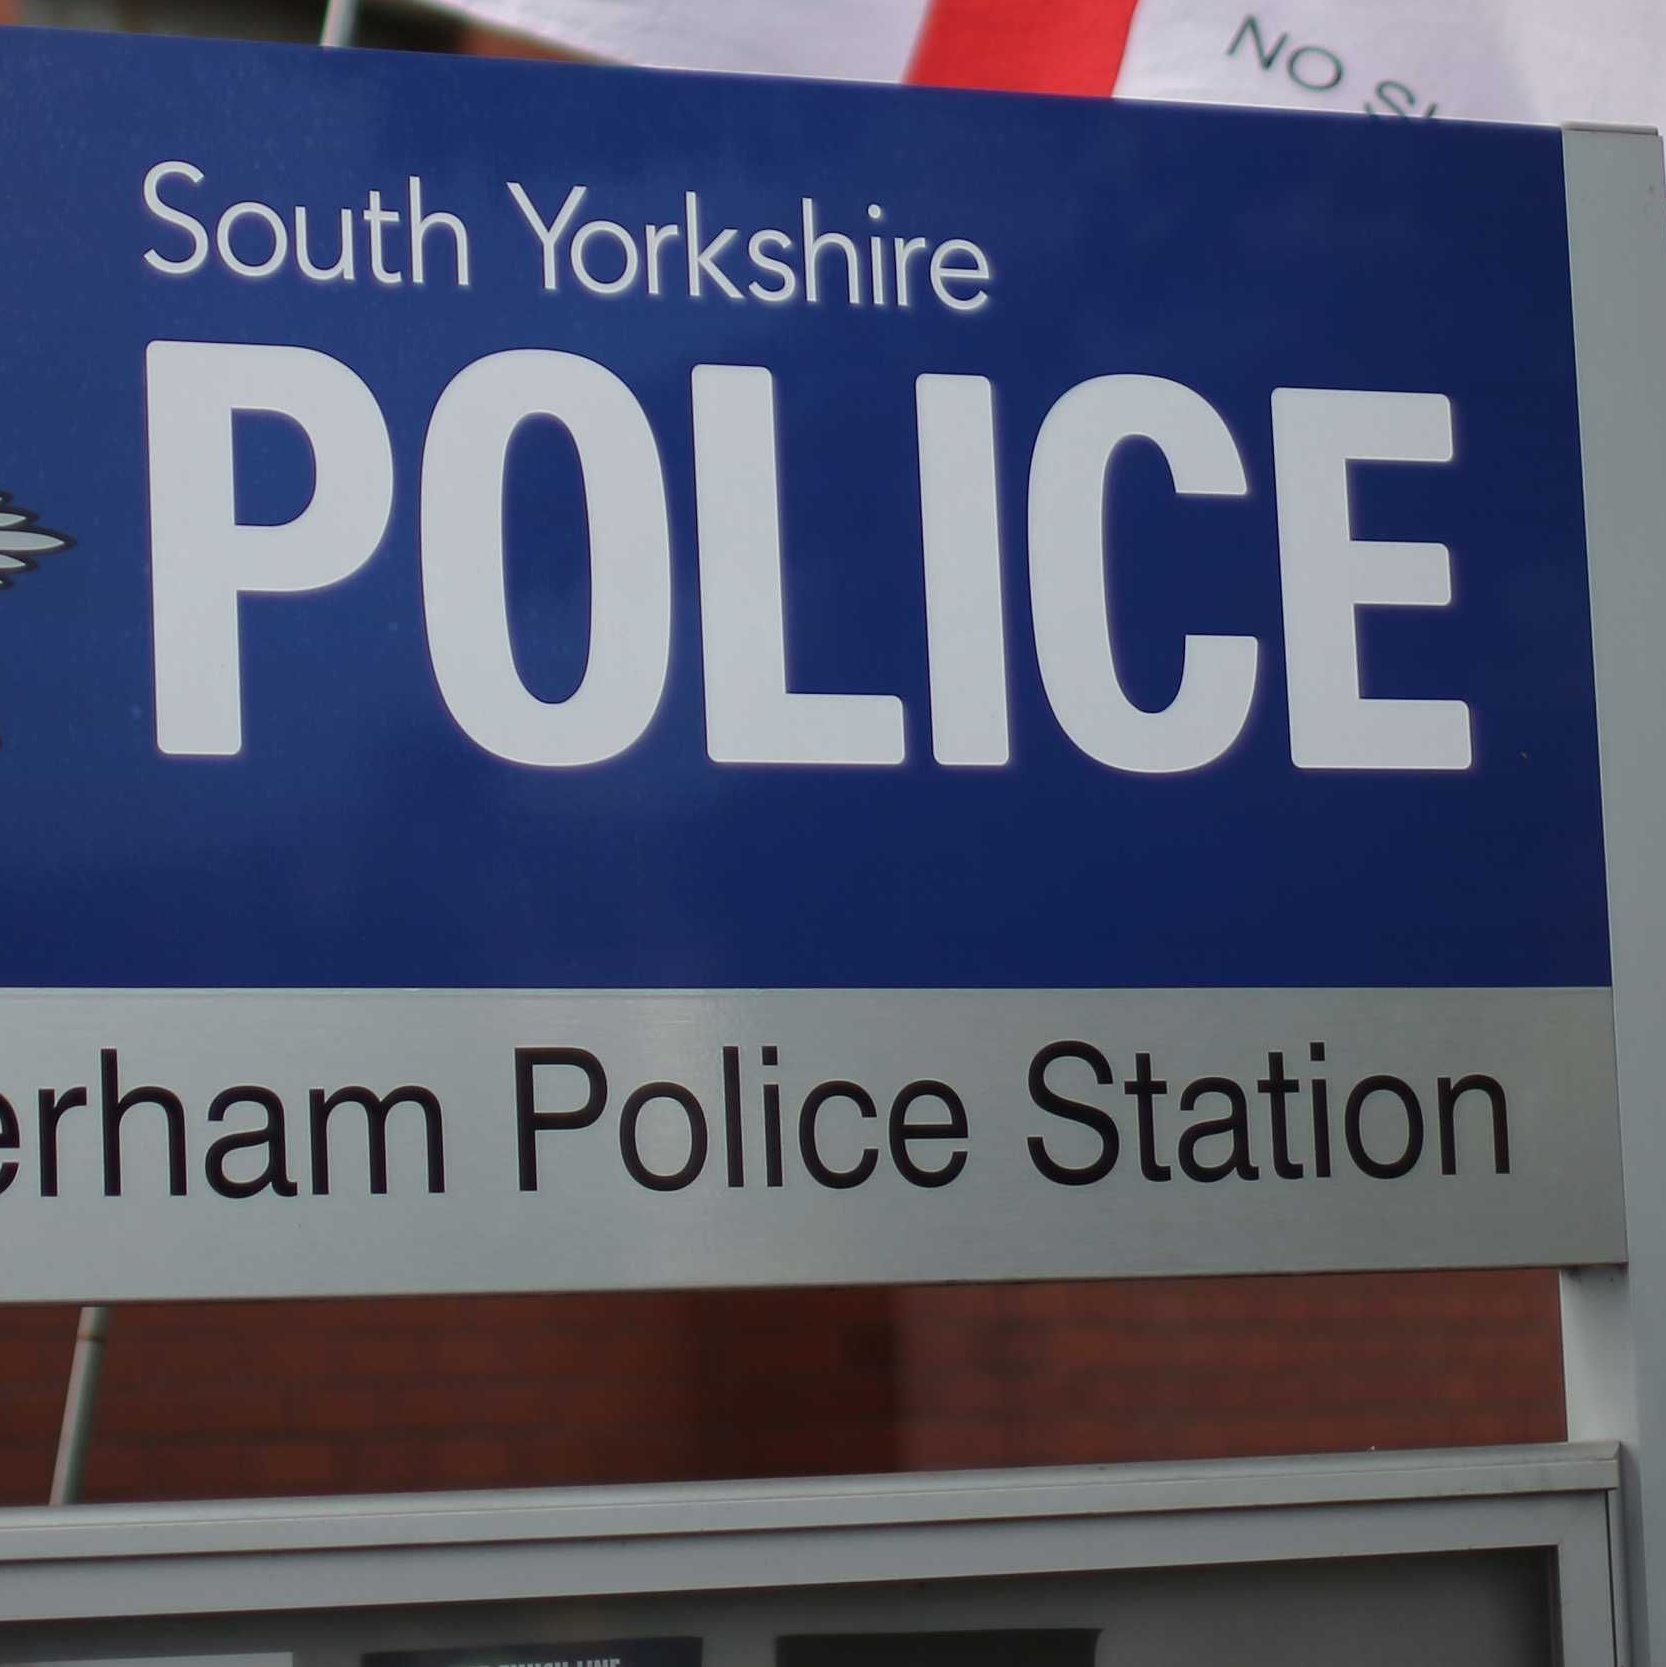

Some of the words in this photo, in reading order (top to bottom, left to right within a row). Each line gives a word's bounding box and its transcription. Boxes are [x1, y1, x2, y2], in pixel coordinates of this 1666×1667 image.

[1227, 13, 1344, 93] NO
[142, 159, 471, 288] South
[505, 180, 992, 312] Yorkshire
[144, 339, 1474, 775] POLICE
[513, 1043, 970, 1193] Police
[1025, 1038, 1512, 1188] Station
